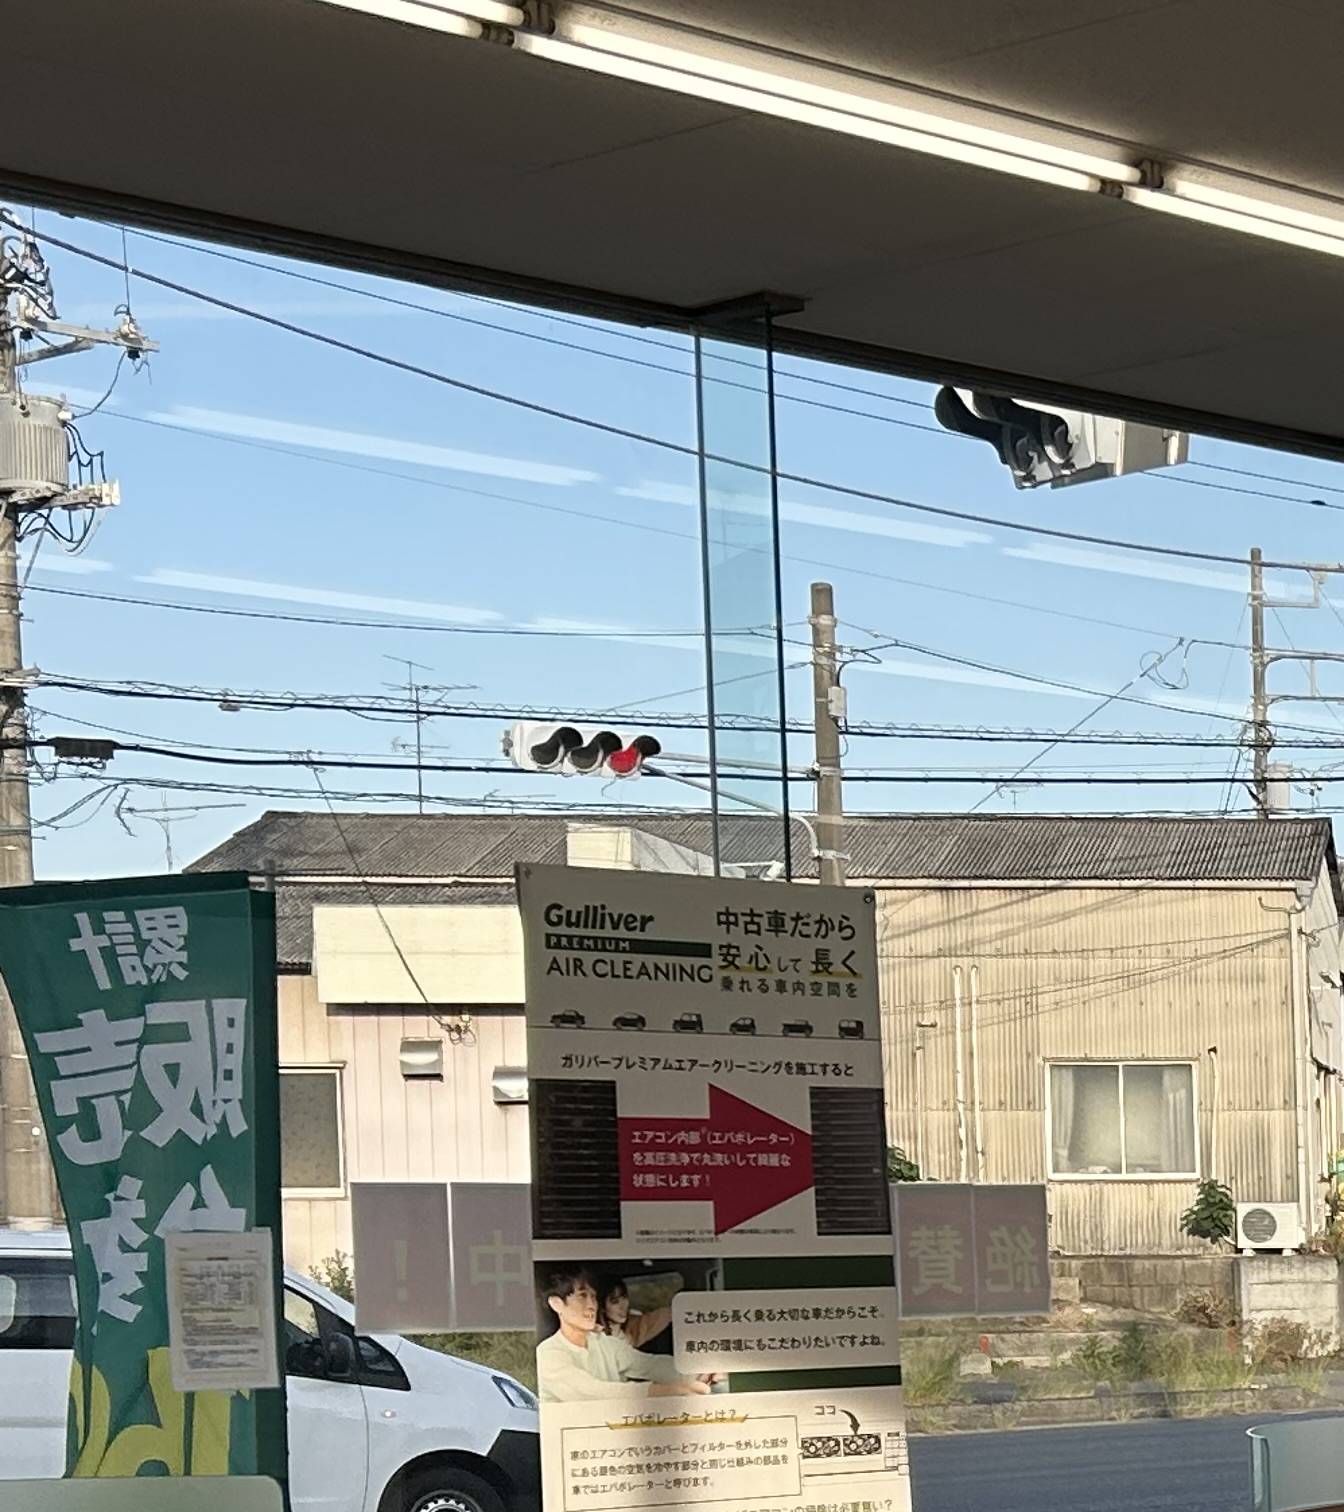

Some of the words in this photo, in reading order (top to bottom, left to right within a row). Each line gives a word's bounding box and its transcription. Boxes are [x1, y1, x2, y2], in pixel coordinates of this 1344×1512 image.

[544, 903, 655, 933] Gulliver
[716, 906, 856, 941] 中古車だから
[551, 935, 630, 951] PREMIUM
[546, 956, 588, 978] AIR
[591, 958, 713, 984] CLEANING
[717, 944, 858, 977] 安心して長く
[720, 975, 858, 998] 乗れる車内空間を
[814, 1405, 837, 1416] ココ
